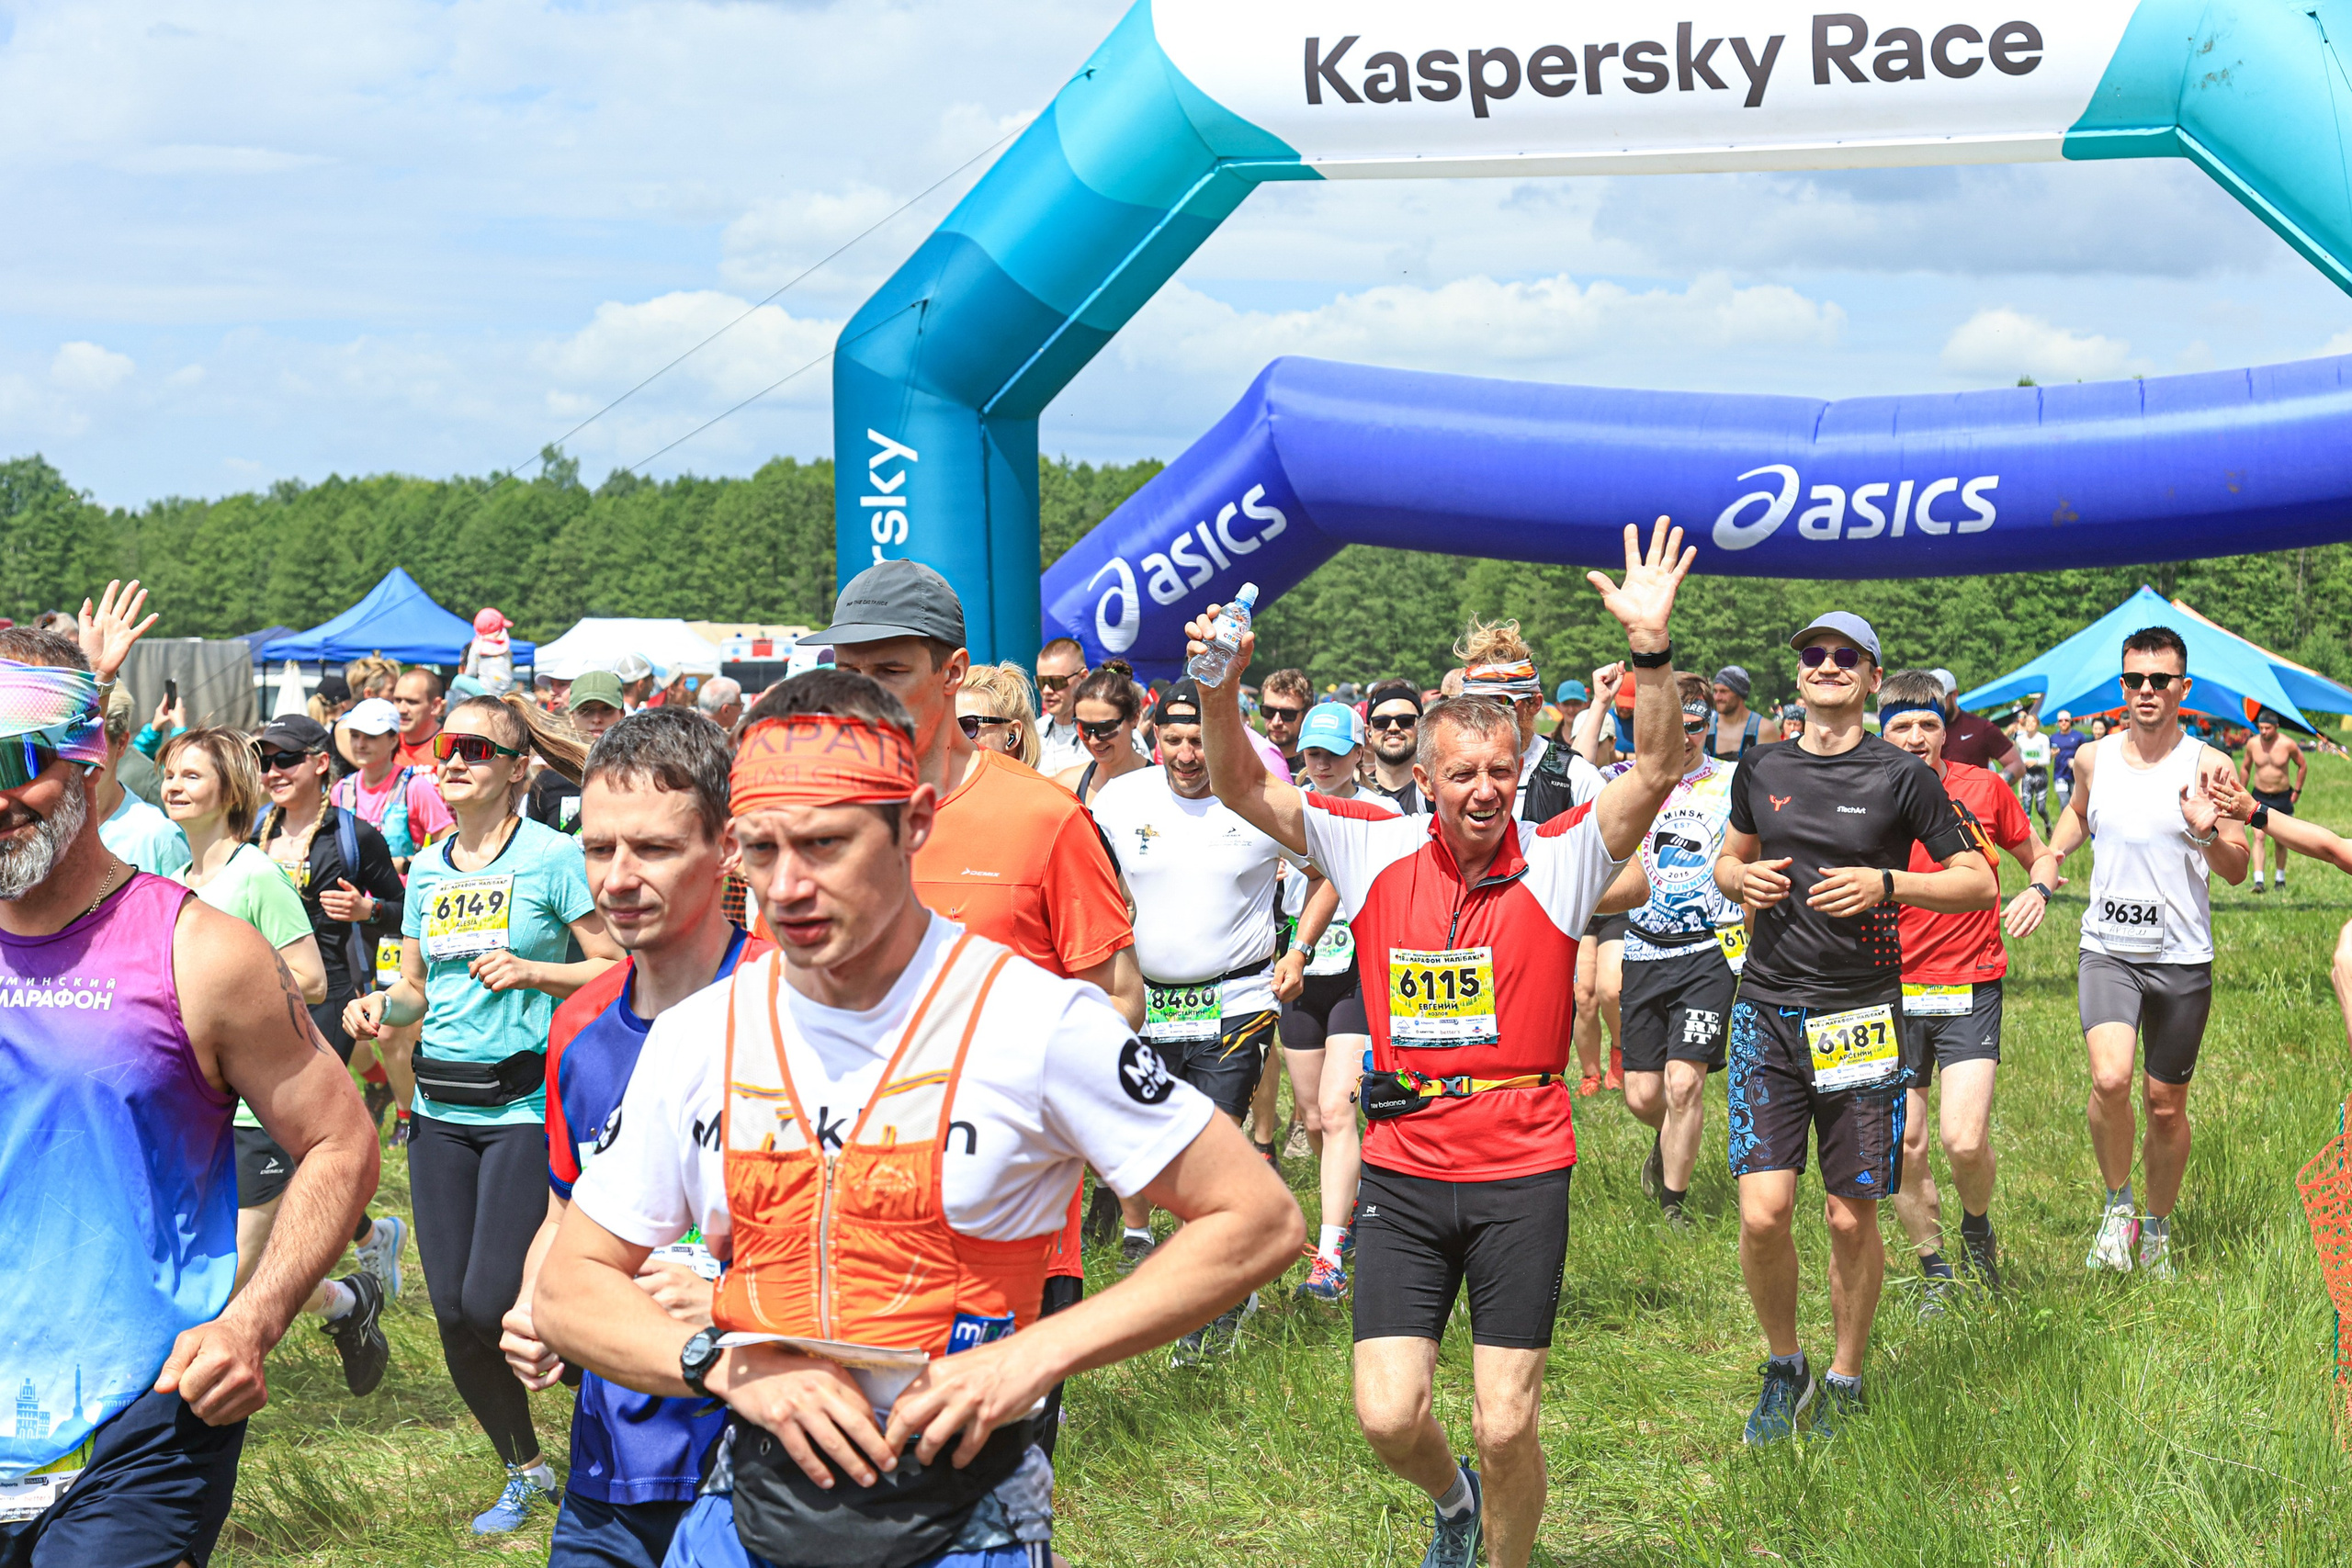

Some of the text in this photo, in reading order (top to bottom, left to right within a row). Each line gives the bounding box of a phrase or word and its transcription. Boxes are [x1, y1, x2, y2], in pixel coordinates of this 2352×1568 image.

[1305, 13, 2044, 118] Kaspersky Race
[1551, 780, 1570, 788] KIPRUN
[1664, 809, 1705, 821] MINSK
[1642, 830, 1664, 887] MIKKELLER
[1667, 865, 1713, 892] RUNNING
[1668, 871, 1690, 879] 2015
[436, 890, 504, 920] 6149
[2105, 900, 2158, 926] 9634
[6, 976, 117, 989] МИНСКИЙ
[1399, 967, 1480, 1000] 6115
[1151, 987, 1216, 1010] 8460
[1419, 1001, 1459, 1010] ЕВГЕНИЙ
[1817, 1021, 1886, 1055] 6187
[1378, 1099, 1407, 1108] balance
